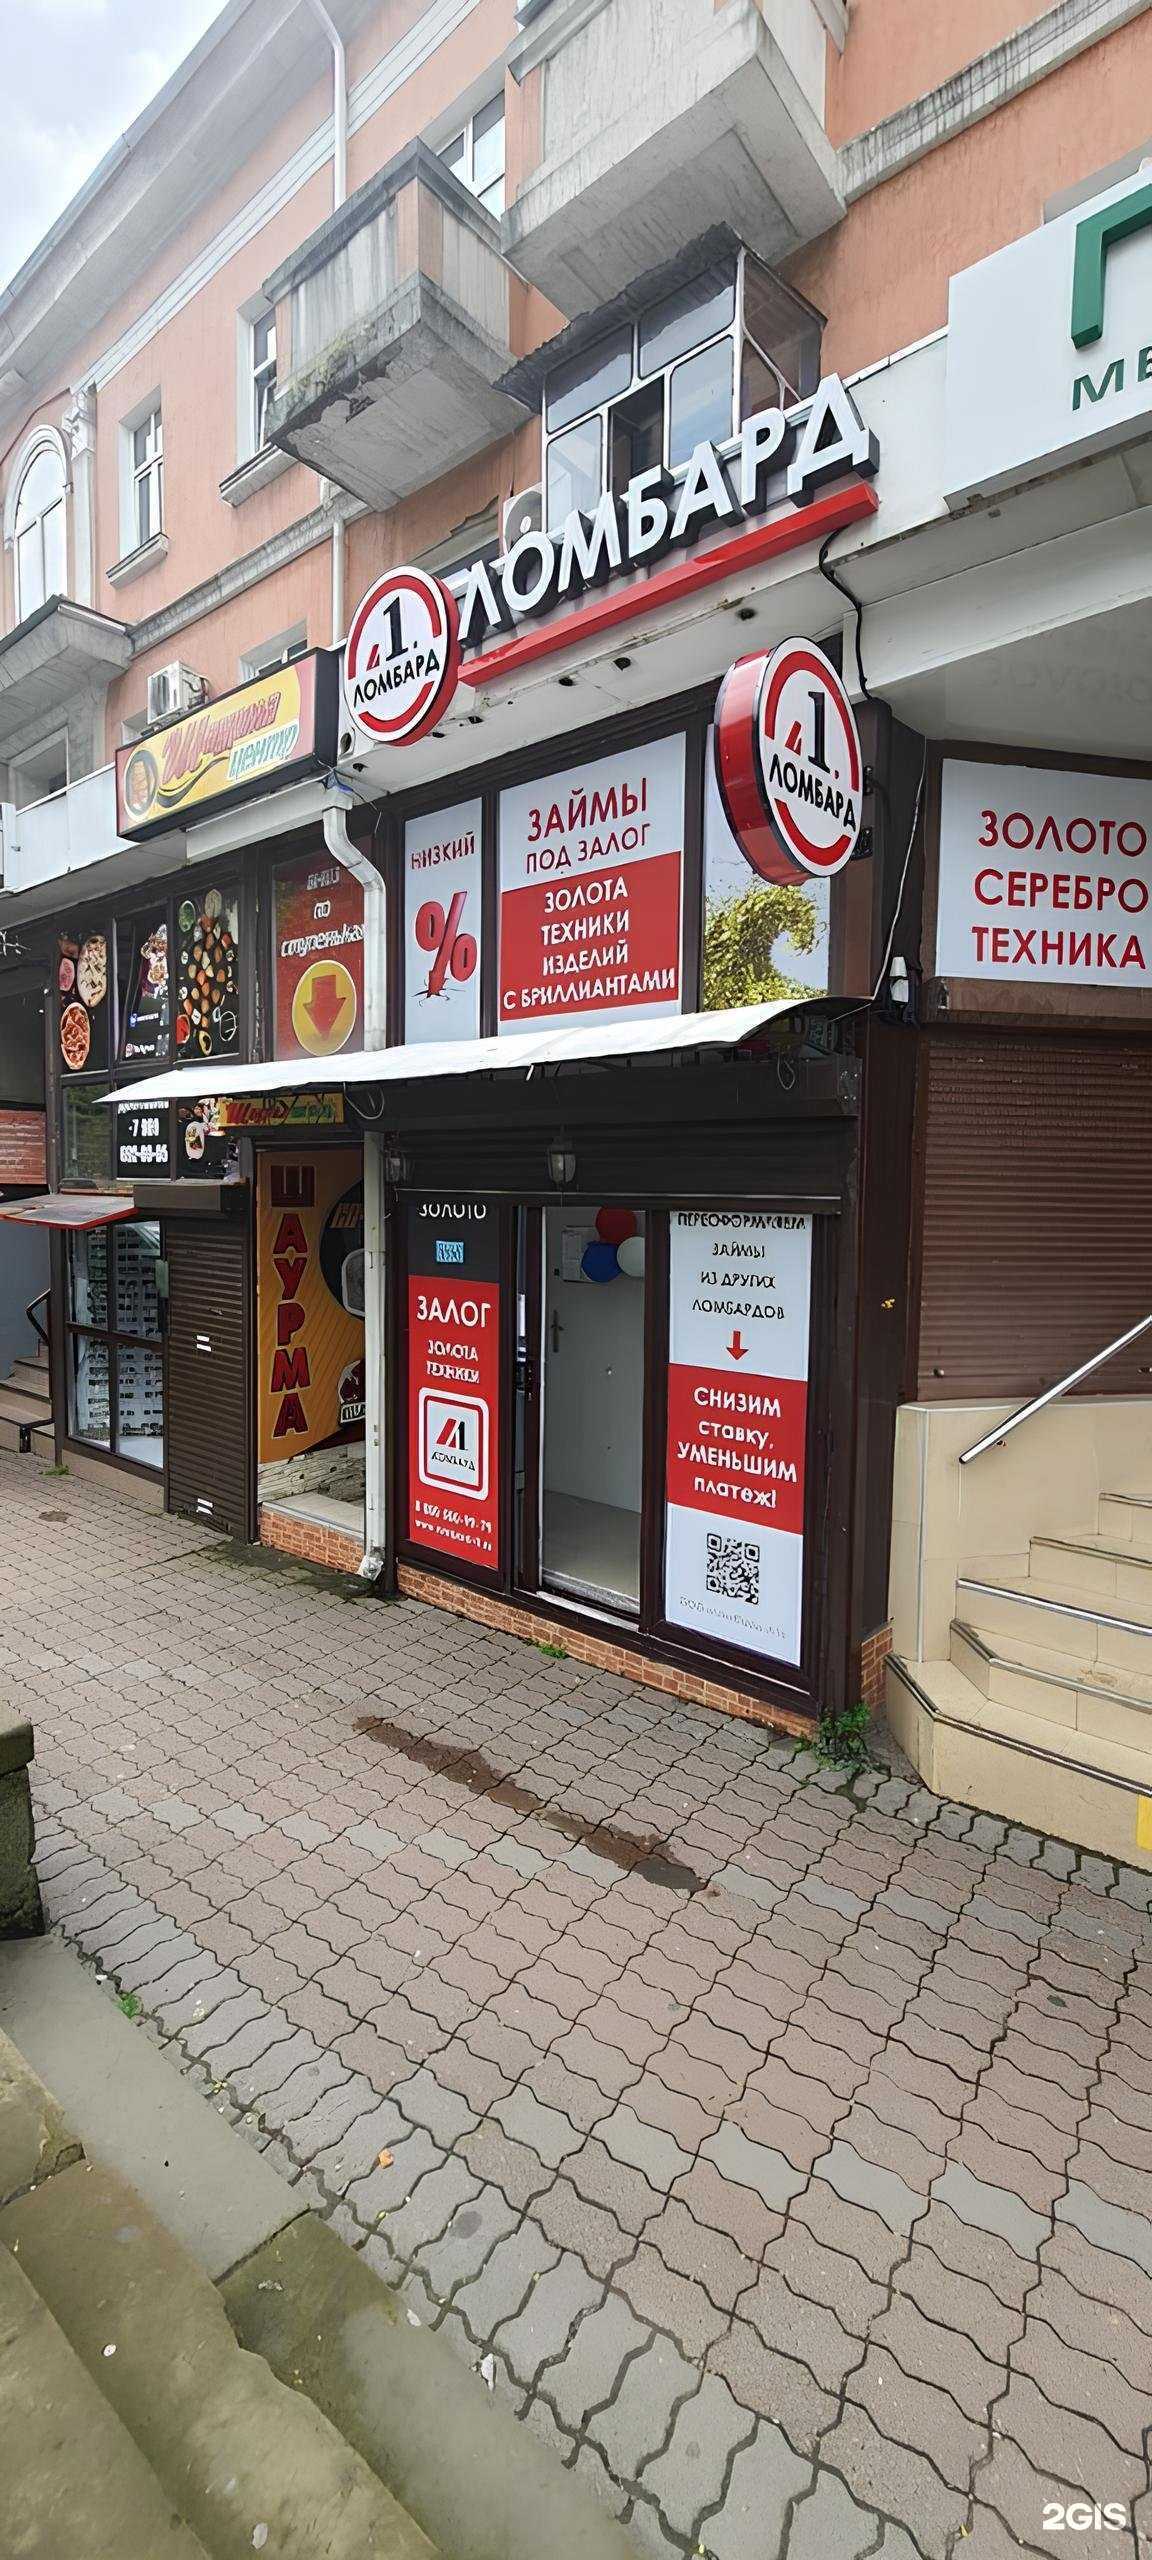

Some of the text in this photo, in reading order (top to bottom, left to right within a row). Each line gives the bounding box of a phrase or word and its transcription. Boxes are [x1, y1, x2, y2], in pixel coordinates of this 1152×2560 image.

[457, 372, 874, 641] ЛОМБАРД
[353, 648, 440, 708] ЛОМБАРД
[527, 777, 647, 842] ЗАЙМЫ
[769, 753, 856, 832] ЛОМБАРД
[411, 831, 475, 870] НИЗКИЙ
[526, 823, 651, 874] ПОД ЗАЛОГ
[978, 810, 1147, 857] ЗОЛОТО
[544, 876, 629, 914] ЗОЛОТА
[974, 868, 1149, 914] СЕРЕБРО
[541, 909, 630, 946] ТЕХНИКИ
[971, 926, 1147, 970] ТЕХНИКА
[542, 939, 629, 976] ИЗДЕЛИЙ
[503, 967, 676, 1010] С БРИЛЛИАНТАМИ
[270, 1165, 315, 1438] ШАУРМА
[416, 1295, 492, 1329] ЗАЛОГ
[694, 1386, 782, 1418] СНИЗИМ
[698, 1420, 775, 1450] ставку,
[677, 1441, 798, 1483] УМЕНЬШИМ
[694, 1476, 777, 1509] платеж!
